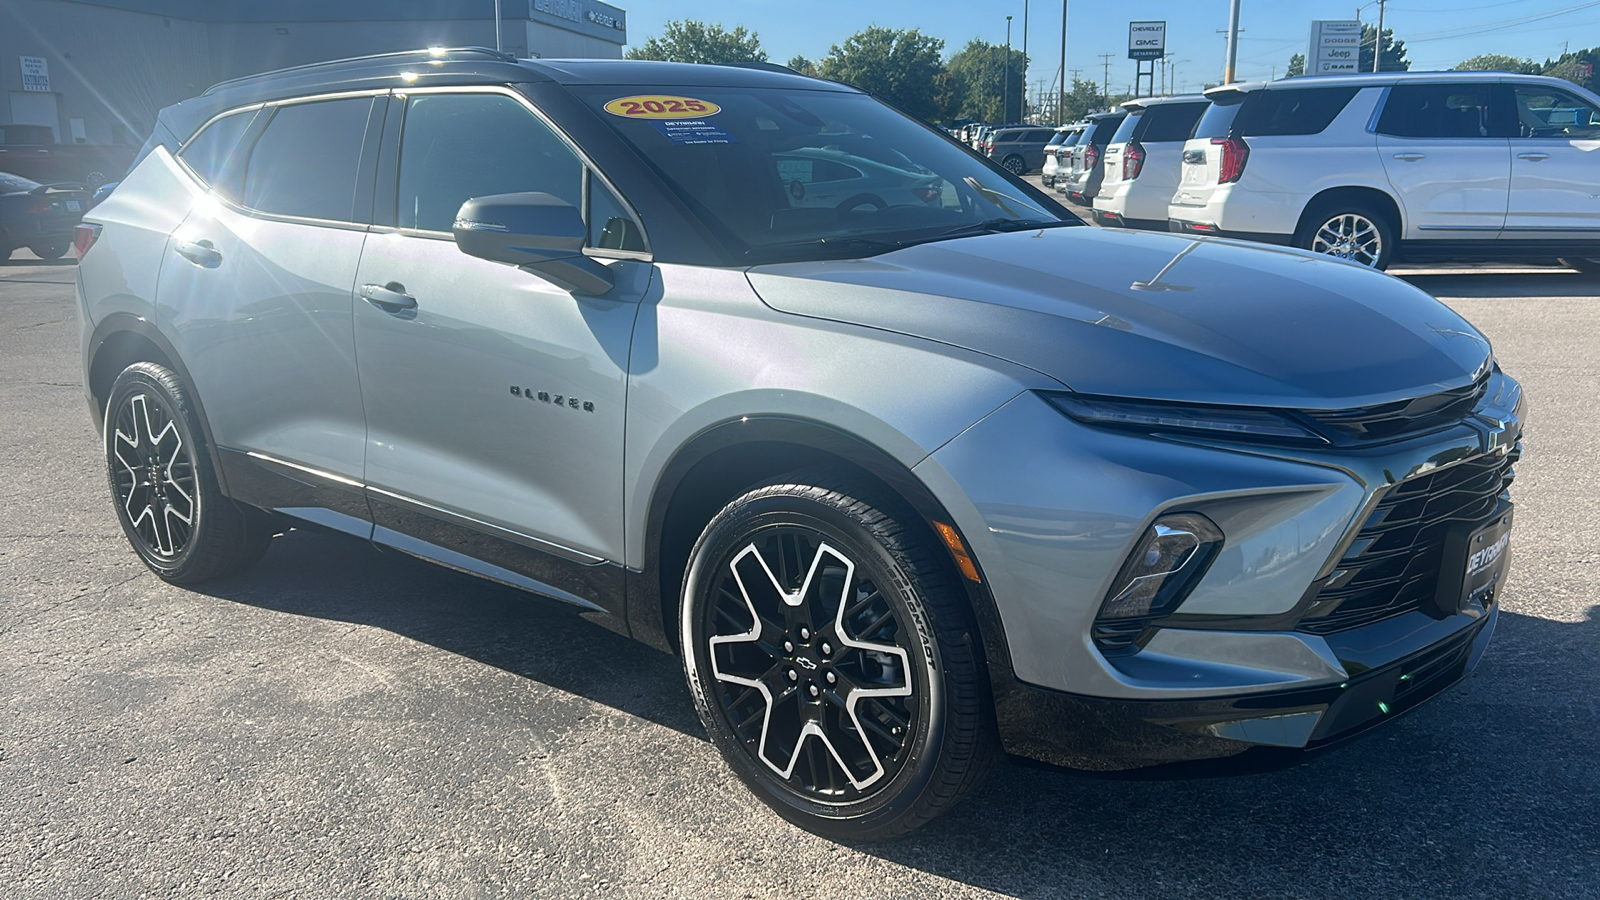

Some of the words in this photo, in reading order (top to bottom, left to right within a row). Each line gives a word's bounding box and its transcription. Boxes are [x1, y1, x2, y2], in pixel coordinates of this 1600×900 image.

[1328, 49, 1350, 58] Jeep
[620, 99, 707, 114] 2025
[509, 385, 595, 413] BLAZER
